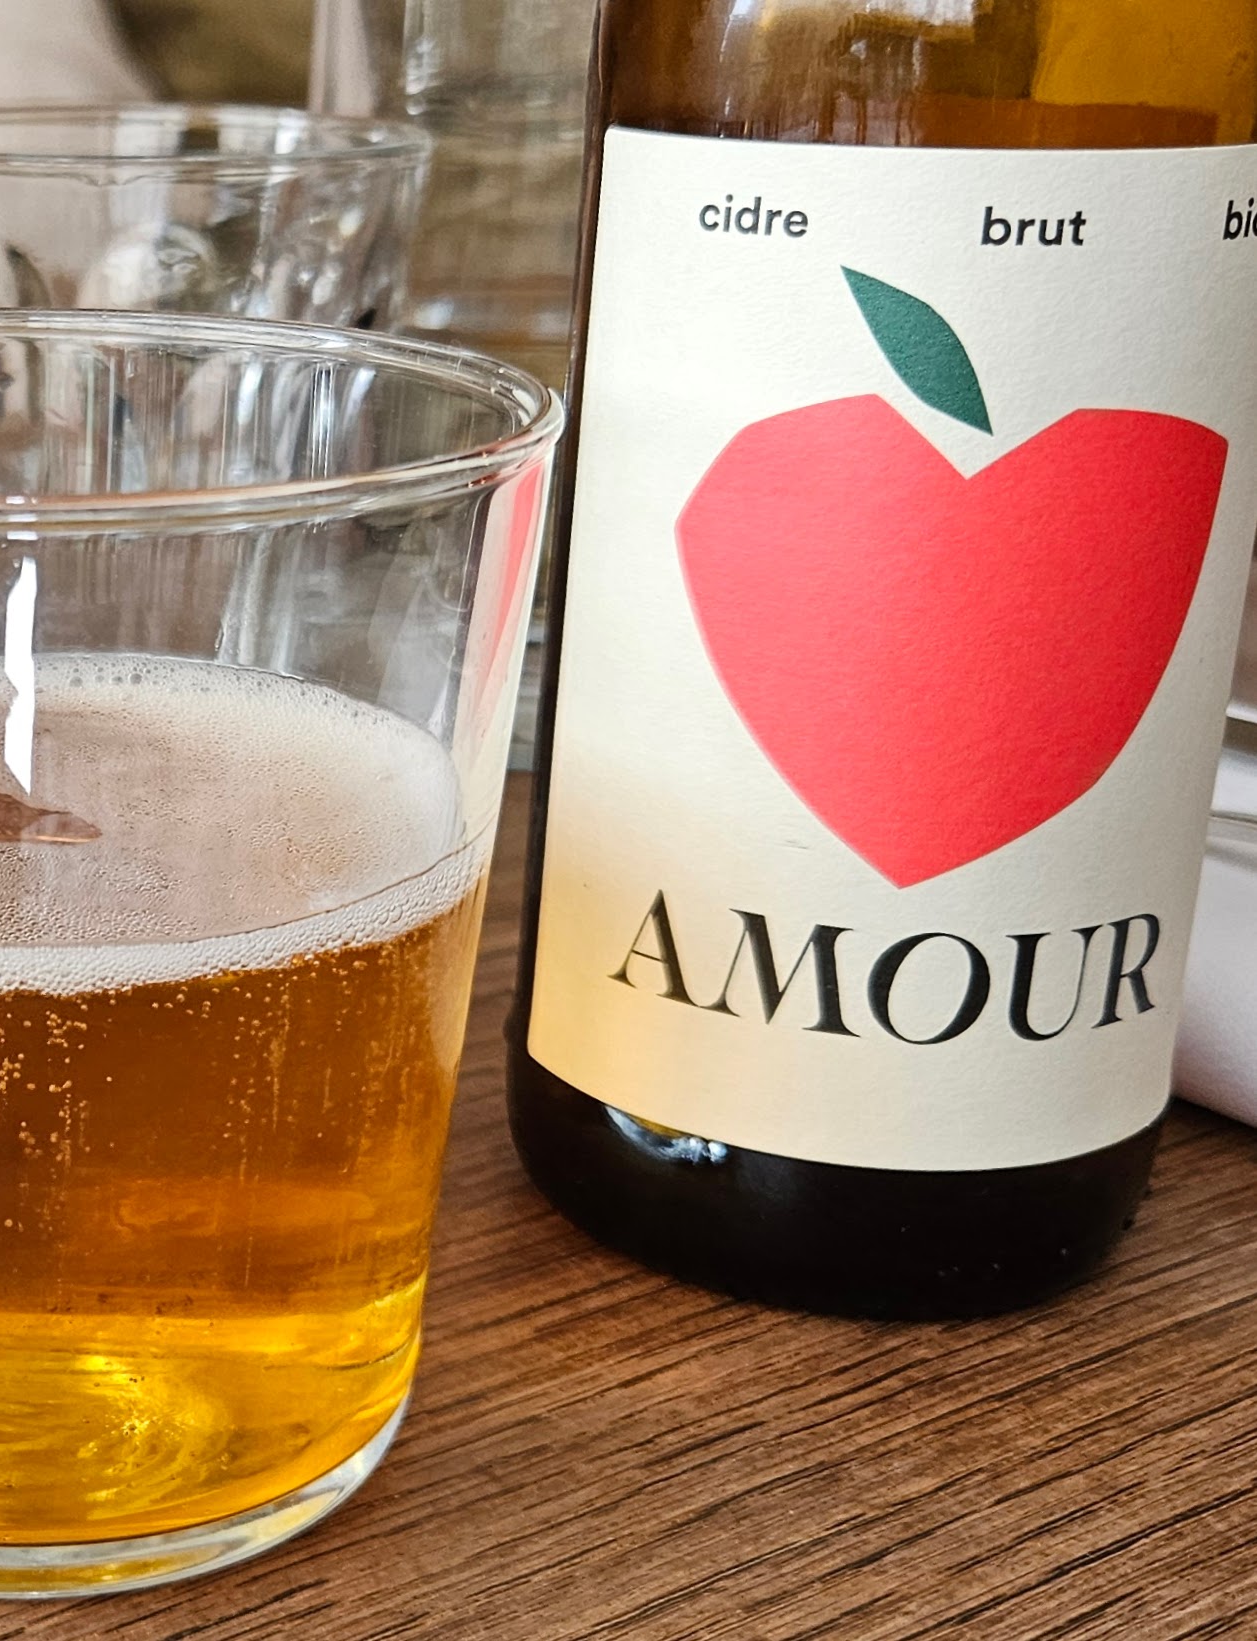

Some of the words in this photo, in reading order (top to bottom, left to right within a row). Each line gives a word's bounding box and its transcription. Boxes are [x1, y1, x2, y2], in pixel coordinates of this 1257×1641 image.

[698, 194, 809, 238] cidre
[980, 206, 1087, 247] brut
[607, 889, 1161, 1046] AMOUR
